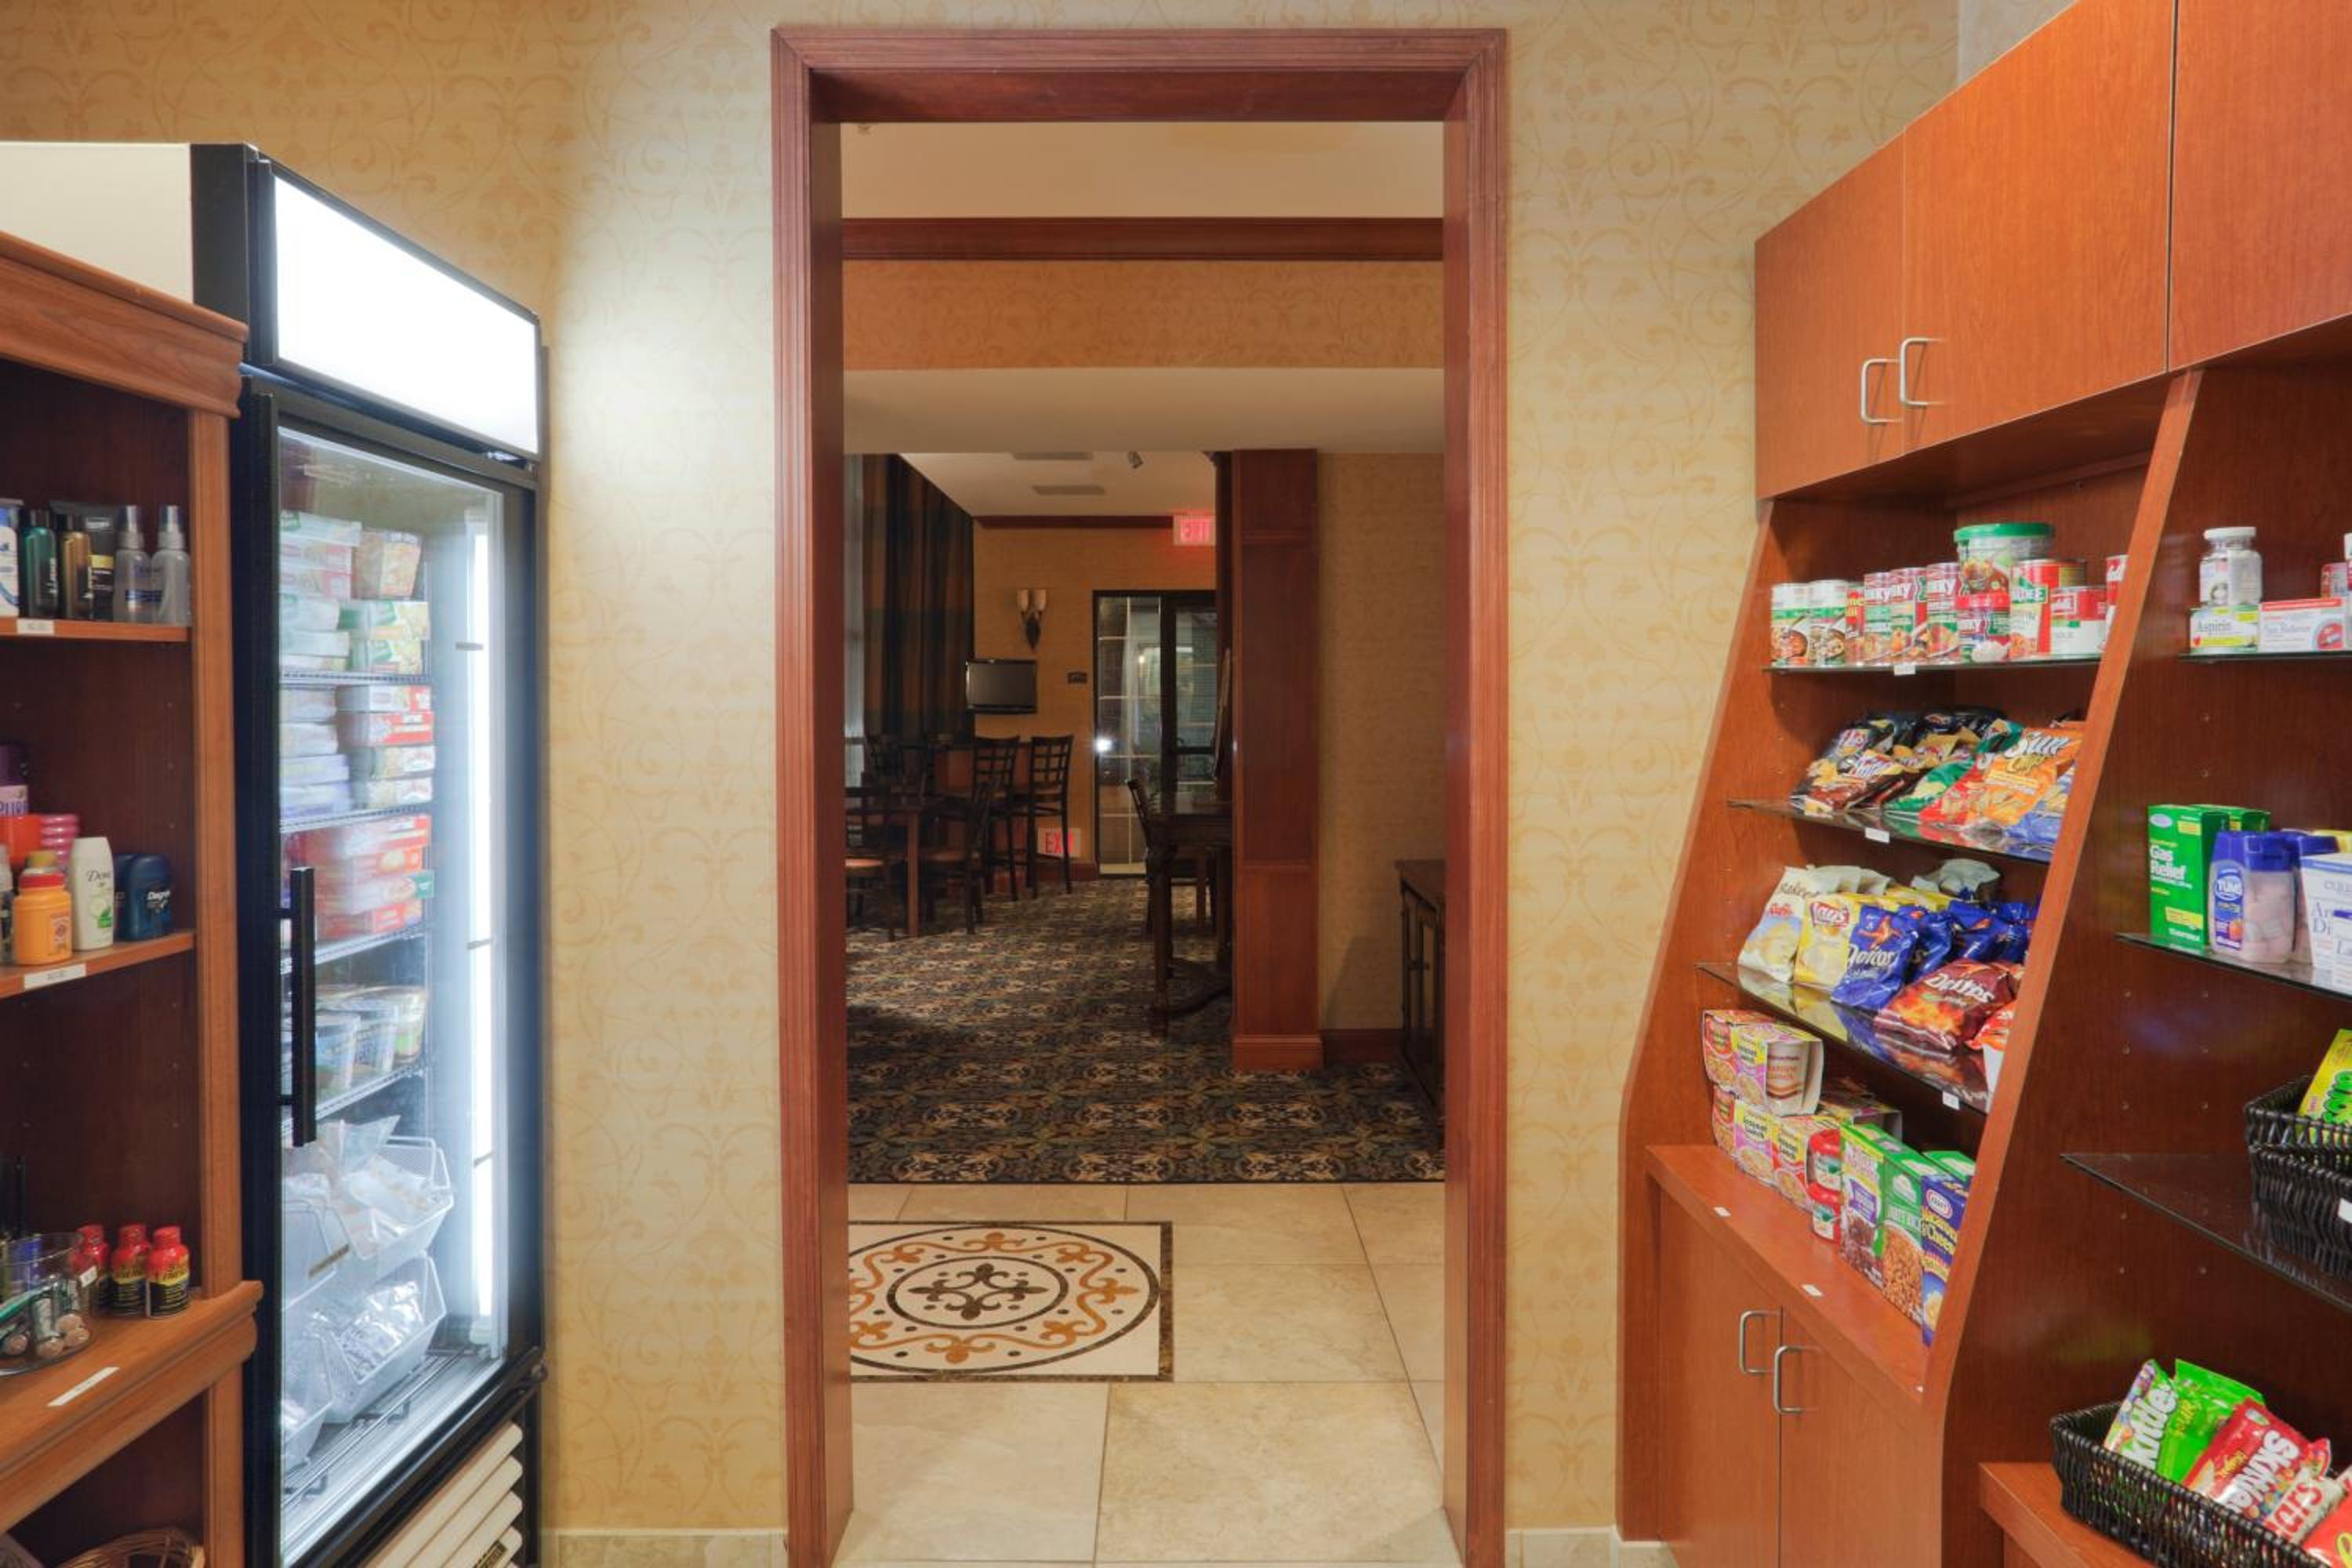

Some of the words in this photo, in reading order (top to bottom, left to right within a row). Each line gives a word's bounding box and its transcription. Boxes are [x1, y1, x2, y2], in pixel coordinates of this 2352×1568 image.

[1179, 519, 1210, 541] EXIT
[1044, 829, 1074, 854] EXT
[2150, 844, 2174, 862] Gas
[1847, 942, 1896, 967] Doritos
